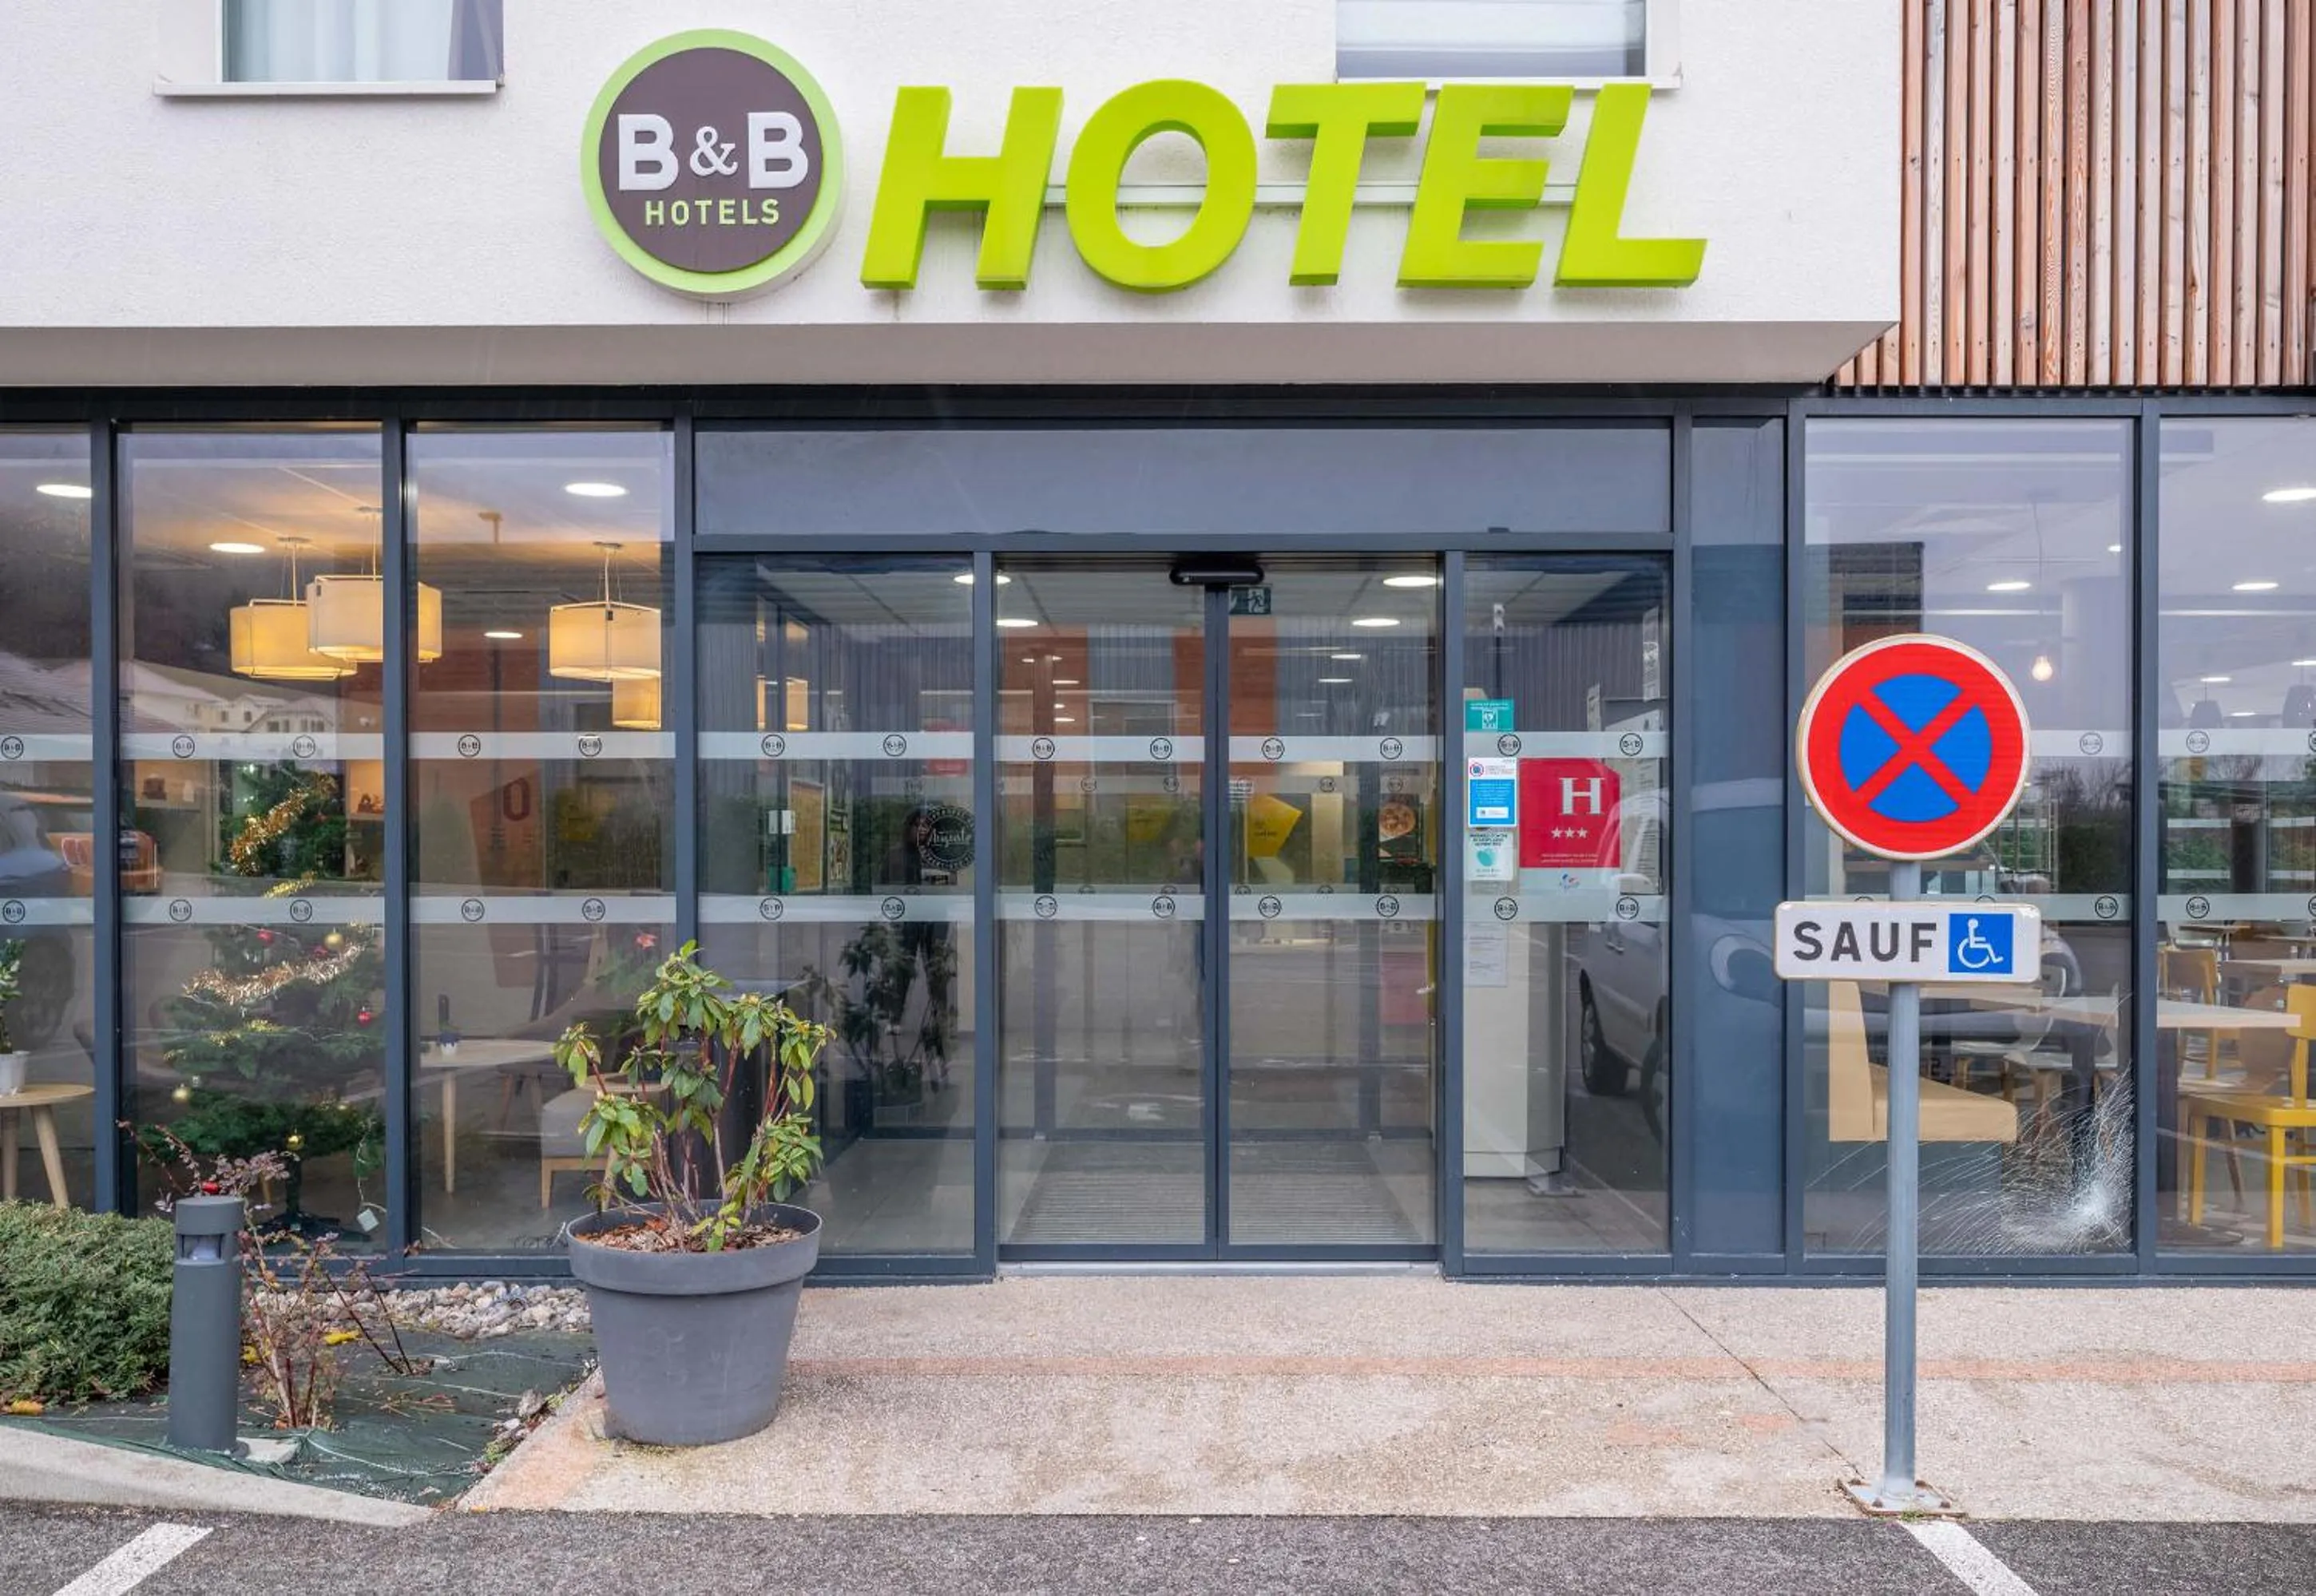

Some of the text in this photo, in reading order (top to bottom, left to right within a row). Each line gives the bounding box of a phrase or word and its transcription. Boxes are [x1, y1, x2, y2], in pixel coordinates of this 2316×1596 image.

[618, 112, 808, 191] B&B
[861, 79, 1707, 291] HOTEL
[645, 199, 779, 226] HOTELS
[1559, 777, 1608, 816] H
[1794, 921, 1937, 962] SAUF
